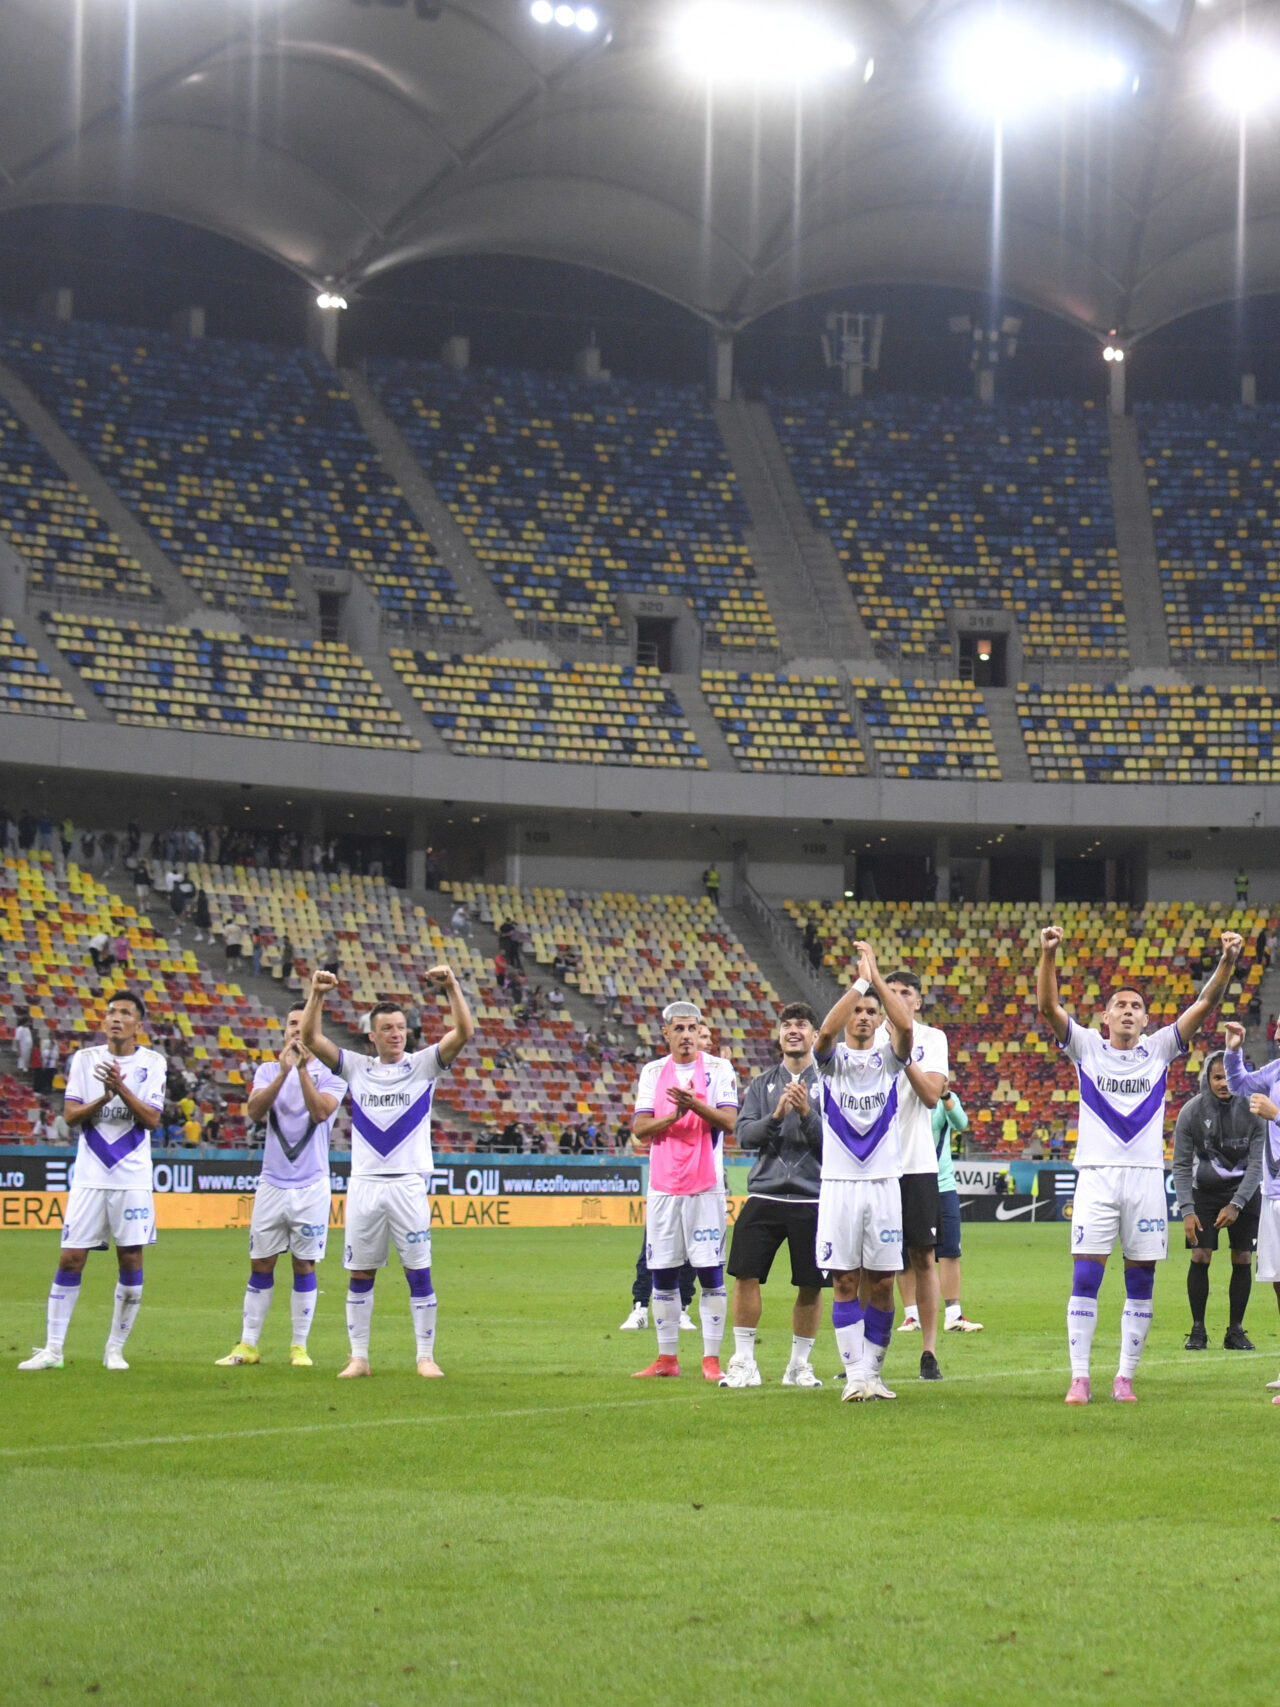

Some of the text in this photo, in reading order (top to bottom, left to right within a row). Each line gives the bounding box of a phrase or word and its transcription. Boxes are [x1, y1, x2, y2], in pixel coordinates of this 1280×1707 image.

[638, 601, 664, 613] 320
[1097, 1075, 1151, 1093] VLAD CAZINO
[361, 1093, 411, 1107] VLAD CAZINO
[860, 1091, 886, 1110] CAZNO
[503, 1174, 640, 1192] www.ecoflowromania.ro
[124, 1208, 149, 1221] one
[451, 1201, 510, 1225] LAKE
[300, 1224, 325, 1237] one
[1136, 1217, 1167, 1233] one
[693, 1228, 721, 1242] one
